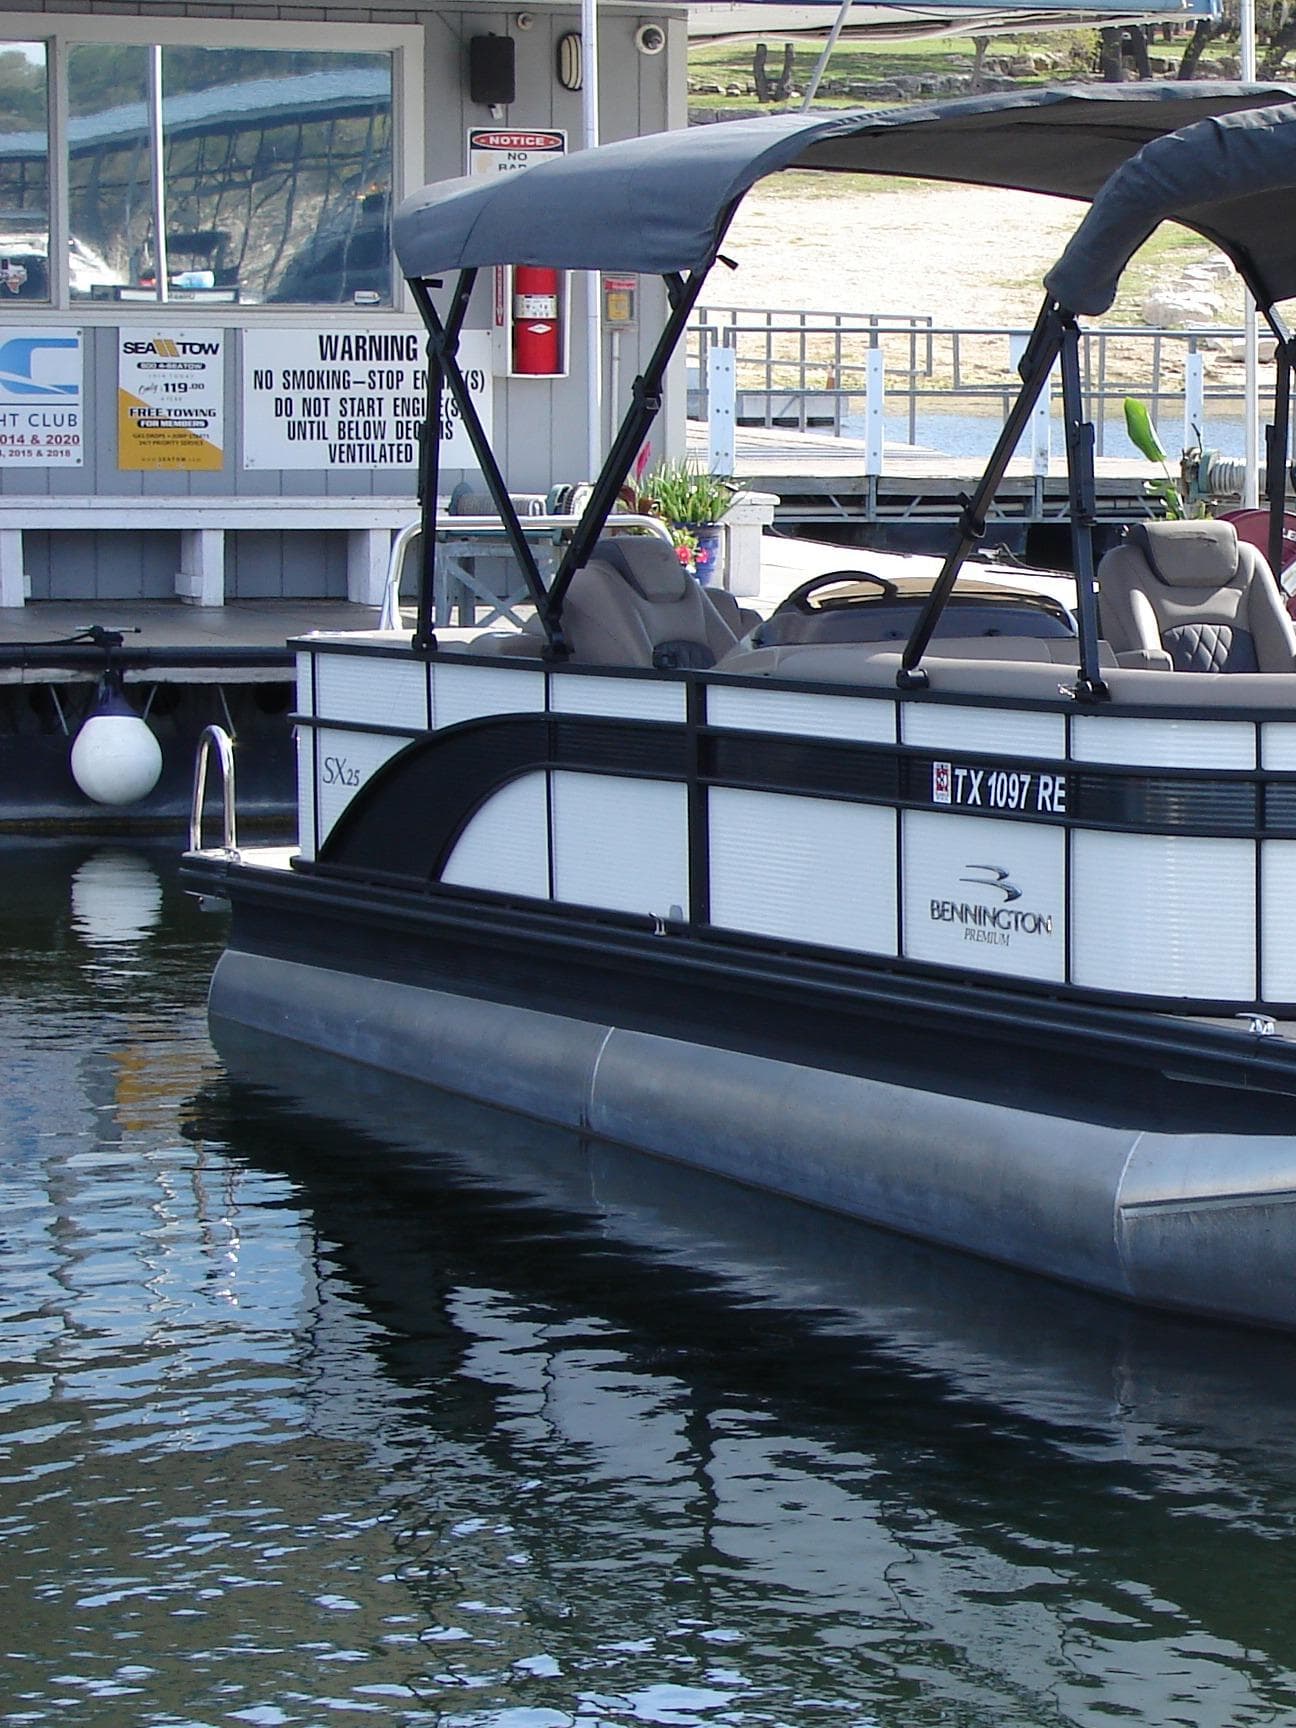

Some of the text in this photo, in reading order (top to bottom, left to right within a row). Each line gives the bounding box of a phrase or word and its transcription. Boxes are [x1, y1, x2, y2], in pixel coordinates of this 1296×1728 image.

[489, 136, 544, 146] NOTICE
[507, 152, 528, 160] NO
[122, 342, 220, 355] SEA TOW
[319, 334, 418, 361] WARNING
[254, 370, 273, 390] NO
[130, 408, 216, 417] FREE TOWING
[275, 398, 292, 418] DO
[302, 398, 330, 418] NOT
[340, 398, 384, 418] START
[28, 413, 78, 428] CLUB
[140, 420, 159, 428] FOR
[30, 434, 40, 445] &
[46, 434, 80, 445] 2020
[288, 421, 329, 440] UNTIL
[338, 421, 386, 440] BELOW
[328, 444, 413, 464] VENTILATED
[954, 768, 1066, 813] TX 1097 RE
[930, 899, 1052, 935] BENNINGTON
[964, 928, 1010, 946] PREMIUM
